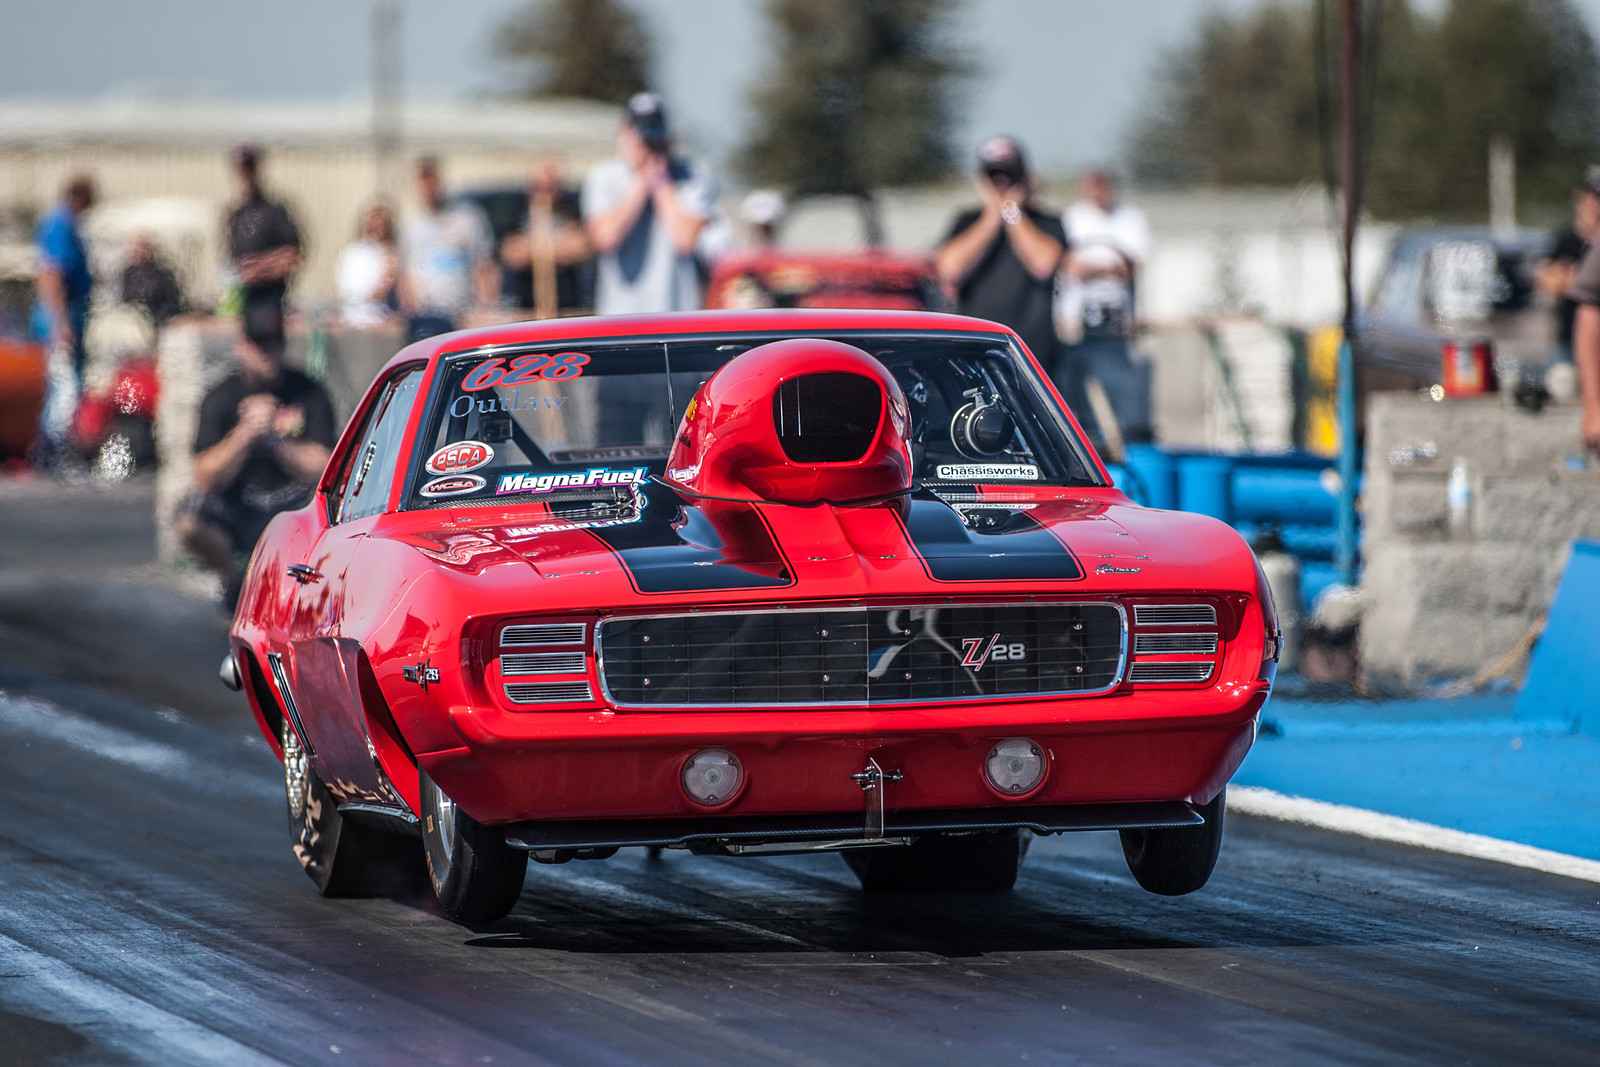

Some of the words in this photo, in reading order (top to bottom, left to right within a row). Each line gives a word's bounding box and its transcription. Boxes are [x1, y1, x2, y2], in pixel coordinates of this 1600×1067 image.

[461, 352, 592, 392] 628
[450, 389, 569, 418] Outlaw
[436, 448, 481, 469] PSCA
[940, 466, 1035, 476] Chassisworks
[430, 480, 475, 493] WCSA
[499, 468, 646, 493] MagnaFuel
[960, 633, 1026, 672] Z/28
